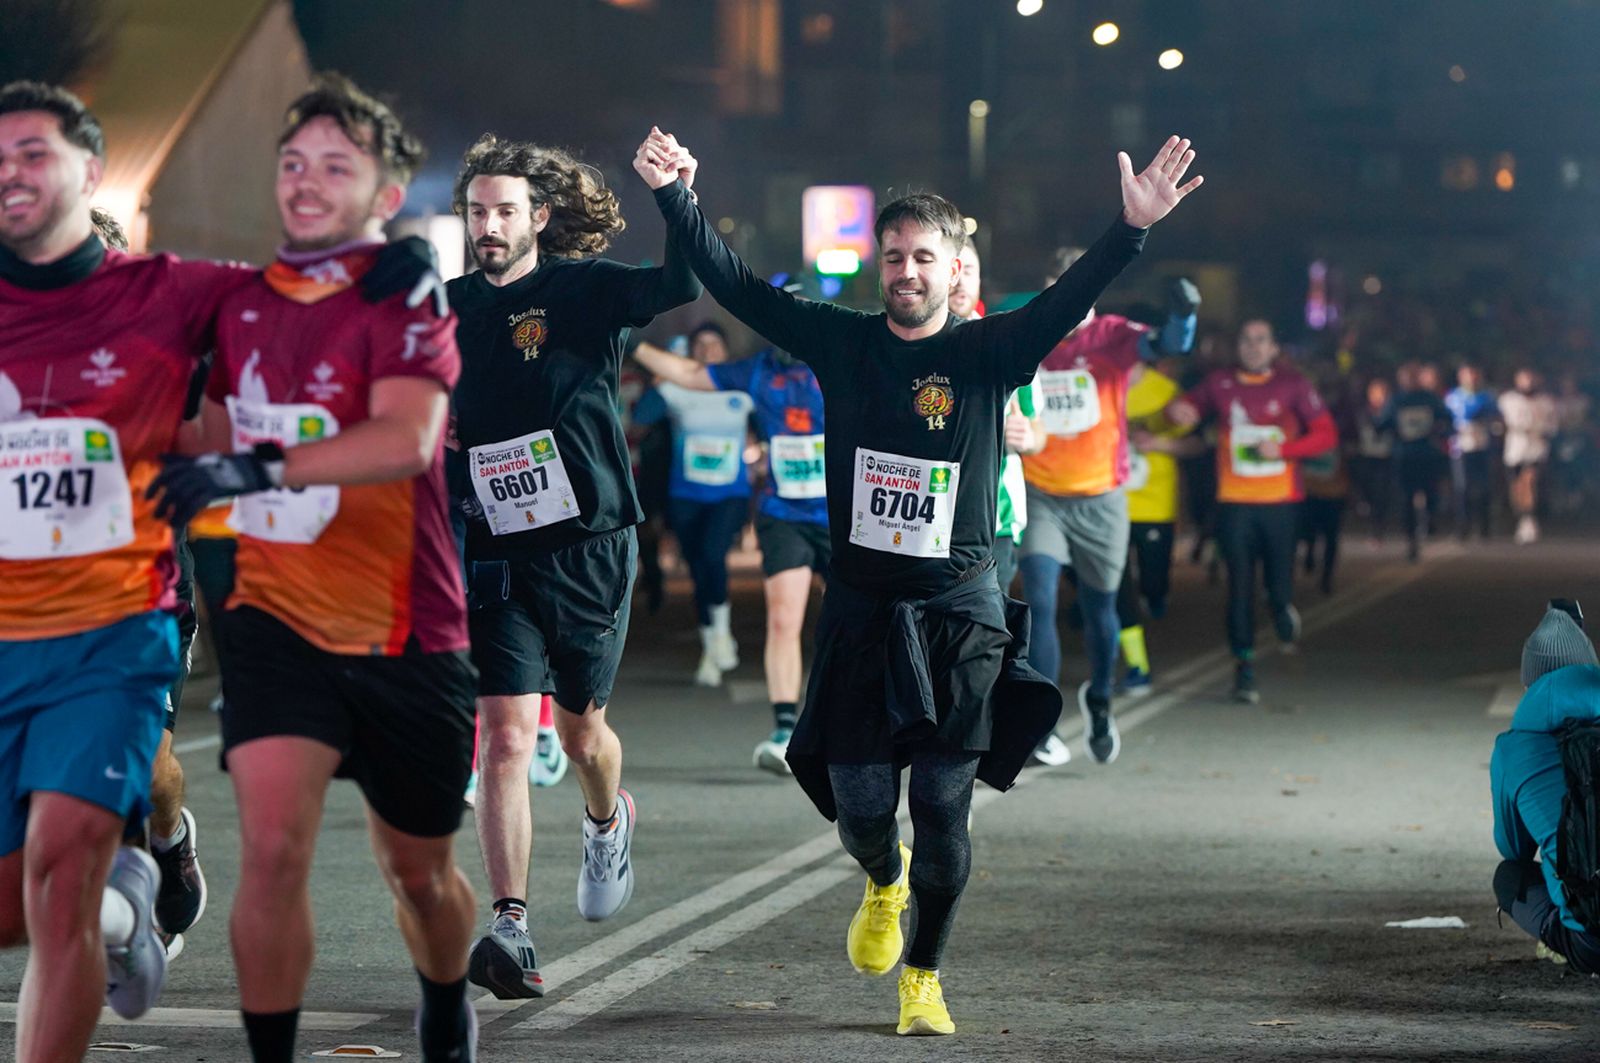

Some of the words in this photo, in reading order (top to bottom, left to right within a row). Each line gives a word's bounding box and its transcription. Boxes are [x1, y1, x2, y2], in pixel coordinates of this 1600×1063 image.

[523, 345, 540, 361] 14
[926, 414, 946, 430] 14
[485, 450, 513, 464] NOCHE
[514, 448, 526, 460] DE
[480, 466, 497, 478] SAN
[499, 457, 530, 474] ANTÓN
[875, 463, 907, 477] NOCHE
[909, 468, 921, 479] DE
[11, 468, 95, 510] 1247
[489, 465, 549, 502] 6607
[864, 472, 883, 486] SAN
[884, 476, 920, 491] ANTÓN
[514, 499, 539, 509] Manuel
[870, 487, 936, 524] 6704
[879, 519, 900, 530] Miguel
